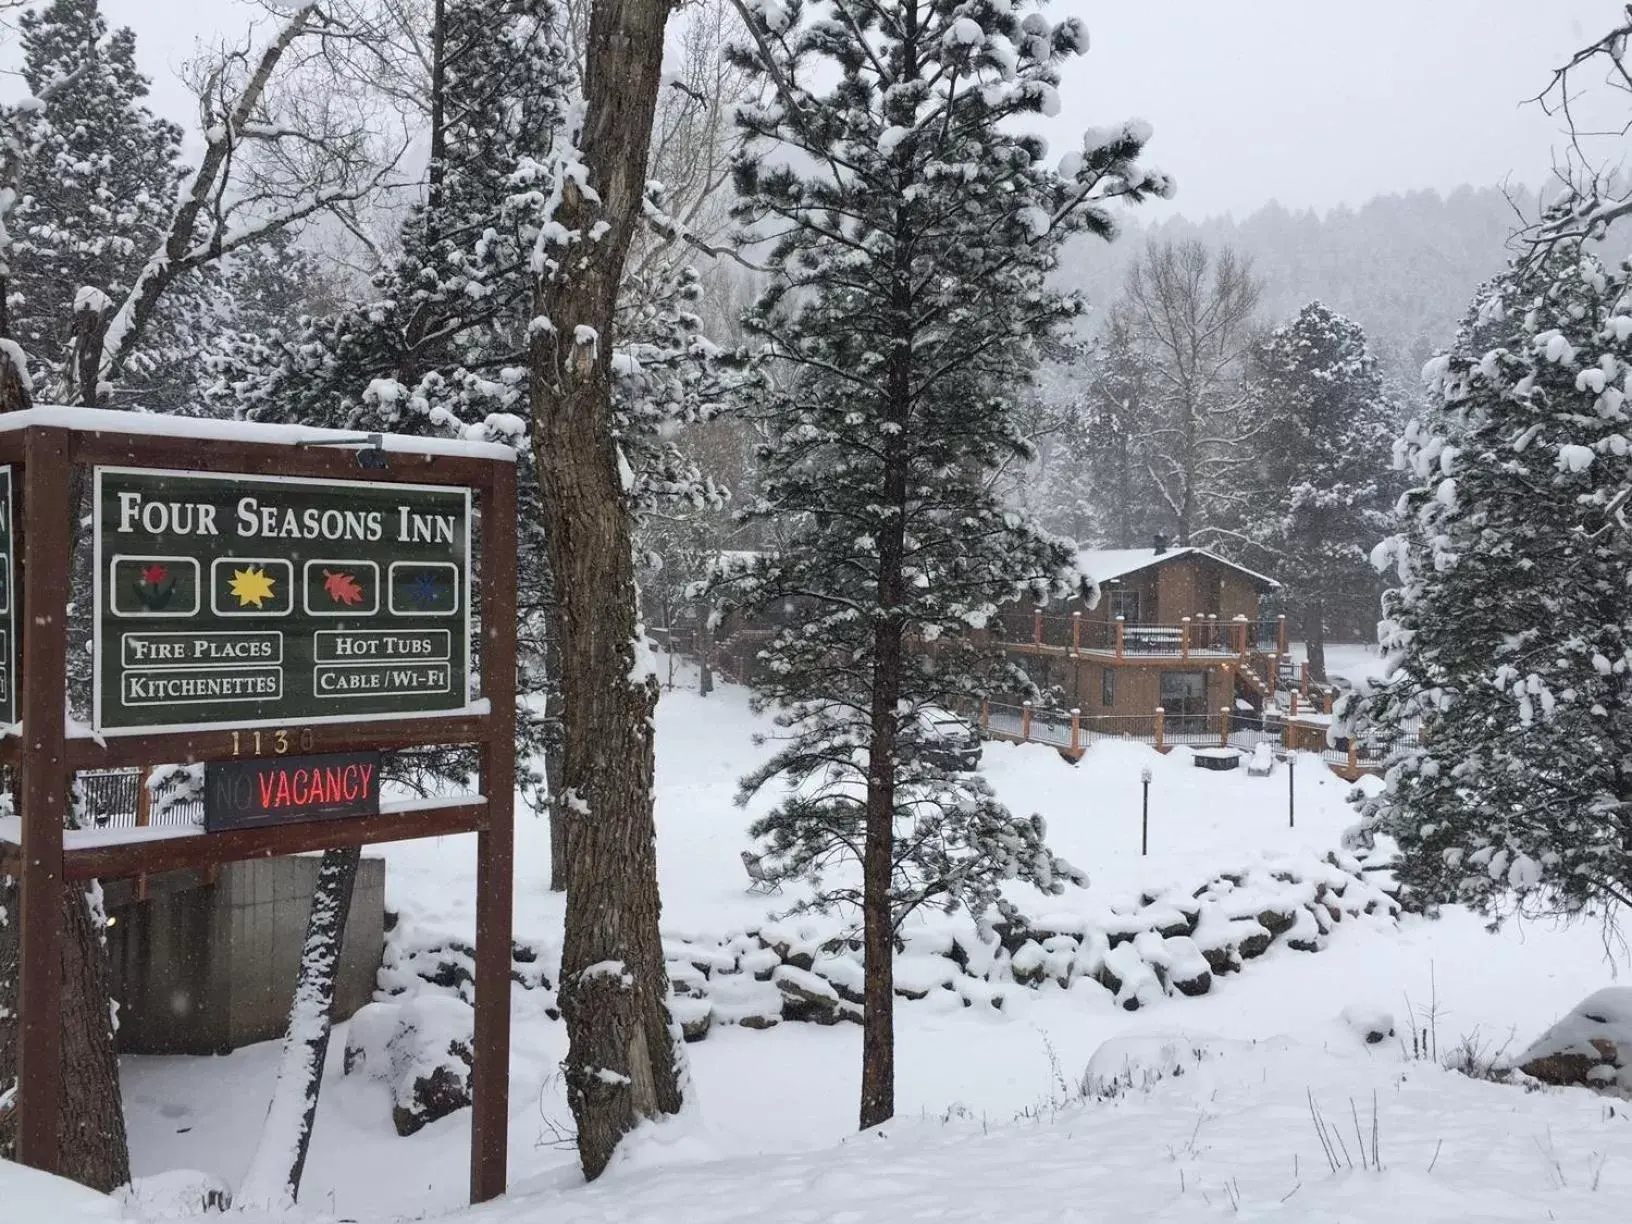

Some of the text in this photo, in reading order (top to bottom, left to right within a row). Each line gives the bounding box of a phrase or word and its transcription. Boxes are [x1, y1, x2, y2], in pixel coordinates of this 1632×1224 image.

[117, 491, 456, 544] FOUR SEASONS INN
[134, 640, 272, 660] FIRE PLACES
[335, 636, 432, 655] HOT TUBS
[129, 676, 277, 698] KITCHENETTES
[216, 763, 373, 810] NO VACANCY
